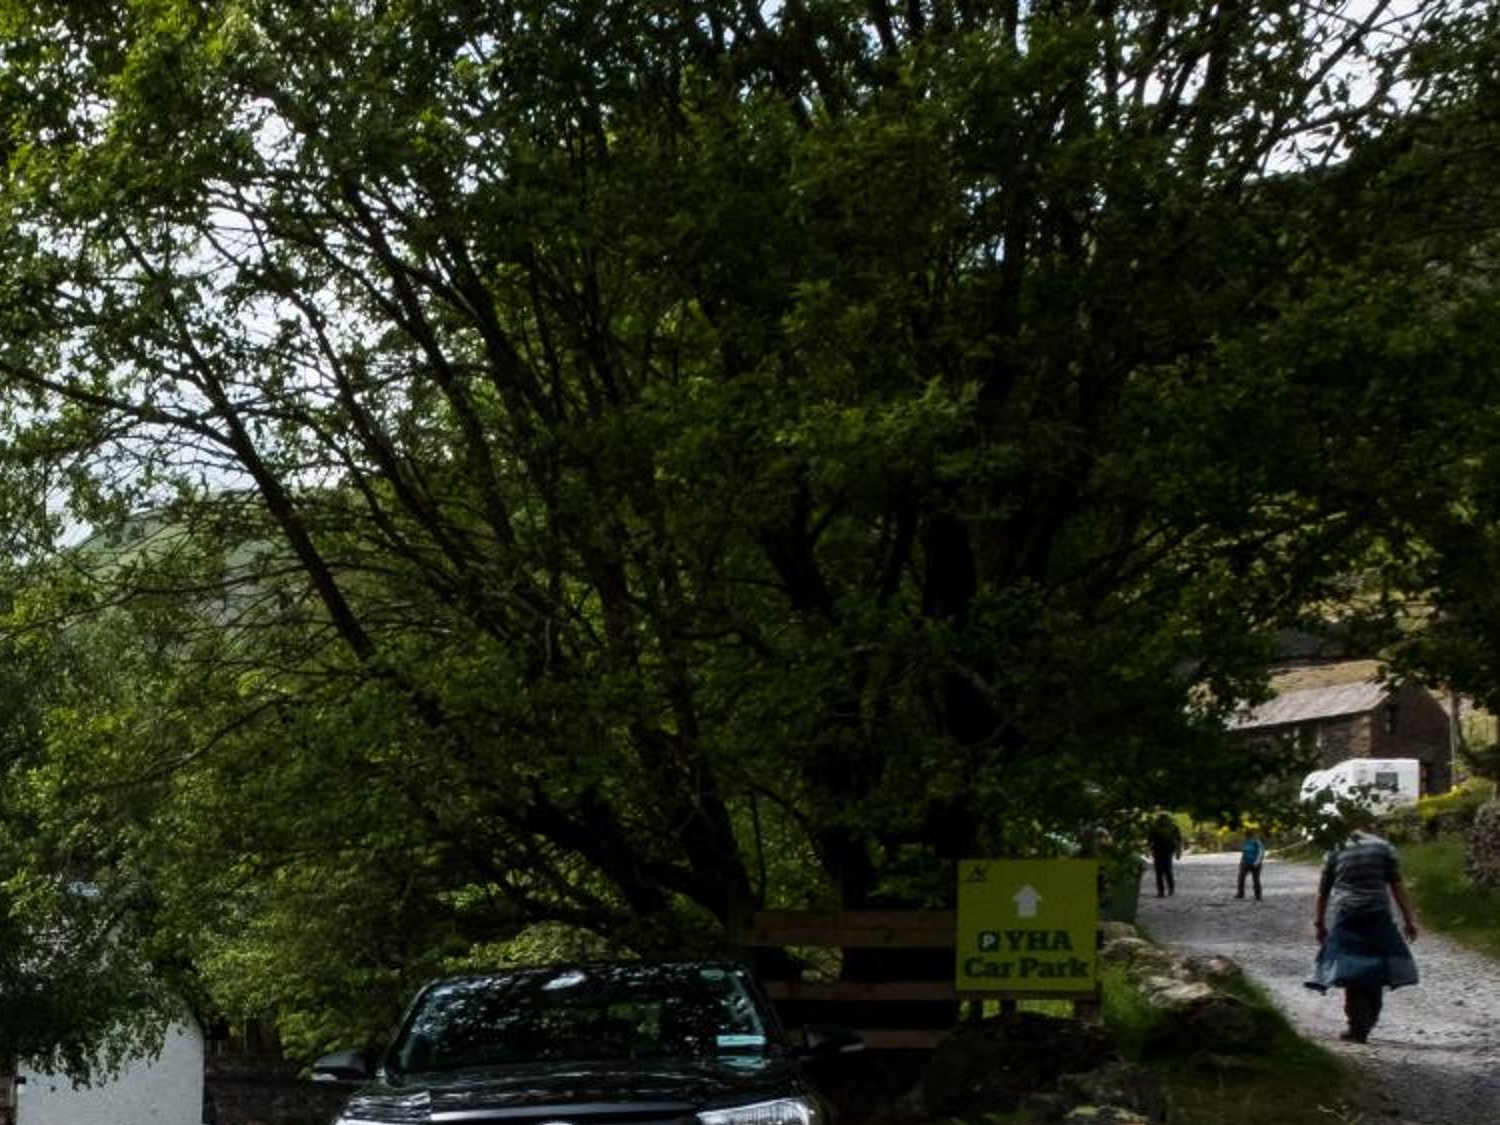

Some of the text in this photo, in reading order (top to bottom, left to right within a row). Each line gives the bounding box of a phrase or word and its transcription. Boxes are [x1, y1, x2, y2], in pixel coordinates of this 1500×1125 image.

[1004, 929, 1073, 950] YHA
[964, 957, 1089, 978] Car Park
